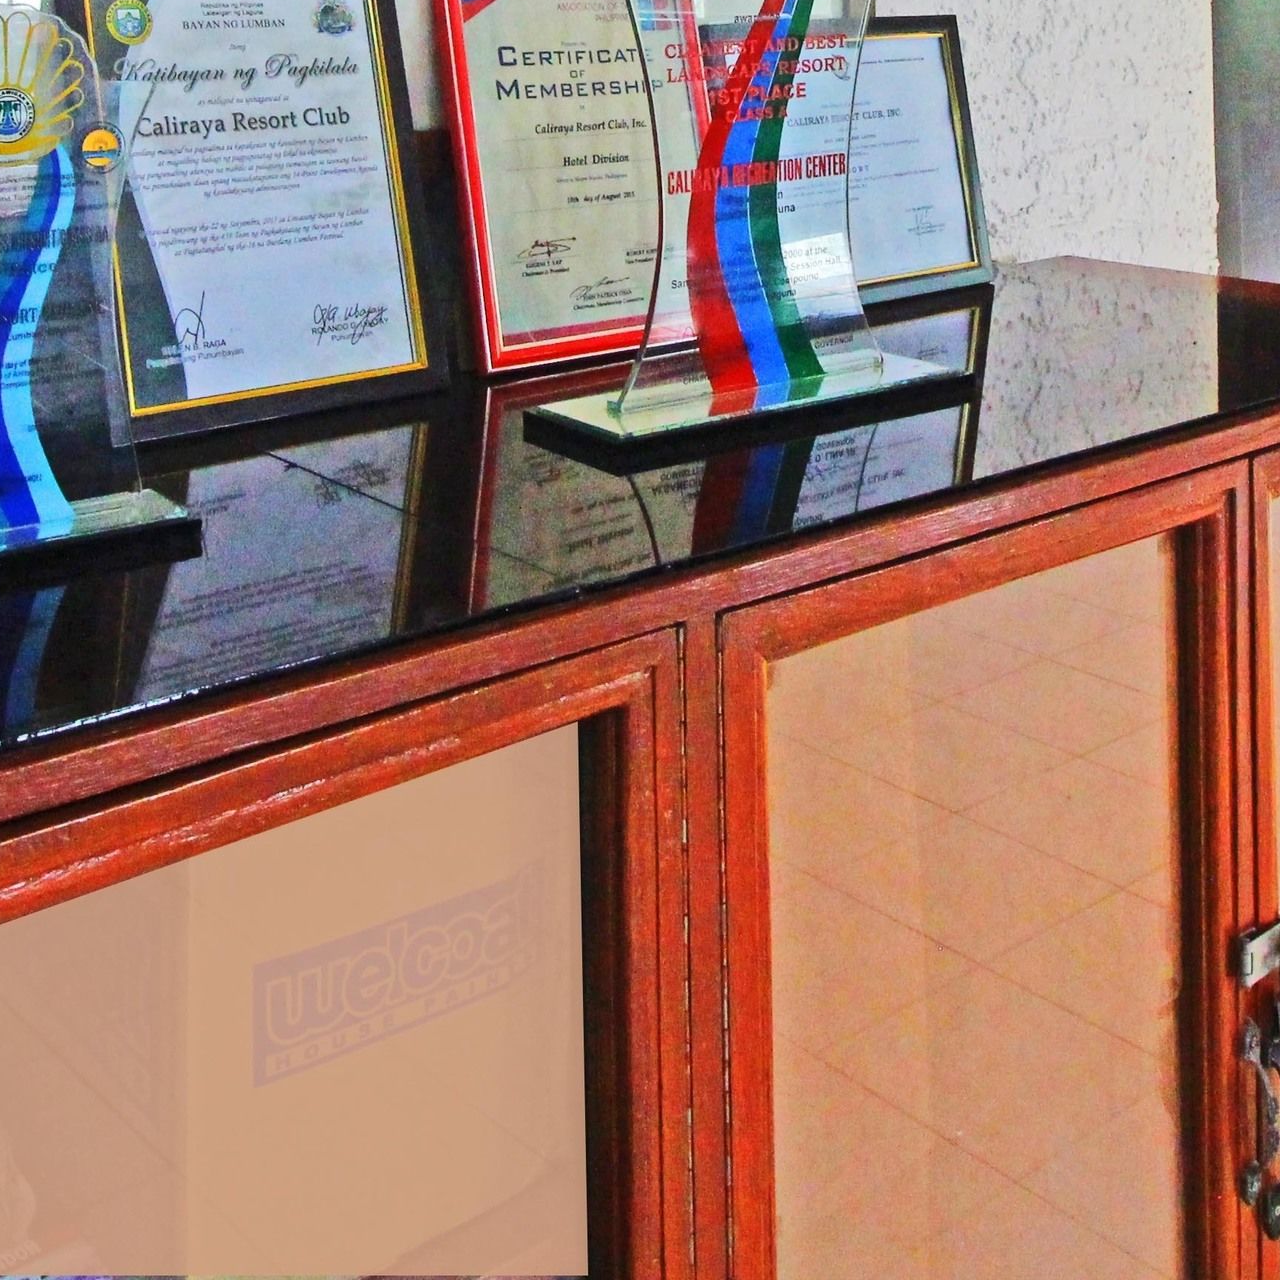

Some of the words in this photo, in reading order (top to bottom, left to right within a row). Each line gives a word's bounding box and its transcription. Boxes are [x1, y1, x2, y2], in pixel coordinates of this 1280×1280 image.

[182, 19, 221, 30] BAYAN
[223, 19, 239, 29] NG
[241, 18, 286, 29] LUMBAN
[665, 39, 758, 60] CLEANEST
[765, 37, 799, 52] AND
[805, 33, 847, 49] BEST
[498, 46, 654, 67] CERTIFICATE
[114, 56, 226, 92] Katibayan
[233, 65, 257, 90] ng
[265, 53, 359, 88] Pagkilala
[570, 70, 585, 79] OF
[778, 57, 846, 75] RESORT
[495, 79, 664, 100] MEMBERSHIP
[748, 83, 806, 102] PLACE
[135, 113, 226, 139] Caliraya
[232, 111, 299, 132] Resort
[302, 104, 350, 126] Club
[726, 107, 773, 124] CLASS
[535, 124, 573, 136] Caliraya
[576, 121, 606, 132] Resort
[632, 118, 647, 129] Inc.
[563, 155, 587, 167] Hotel
[592, 152, 630, 165] Division
[667, 166, 729, 195] CALIRAYA
[731, 159, 803, 188] RECREATION
[805, 152, 846, 179] CENTER
[601, 193, 621, 202] August
[817, 245, 828, 256] the
[790, 259, 824, 271] Session
